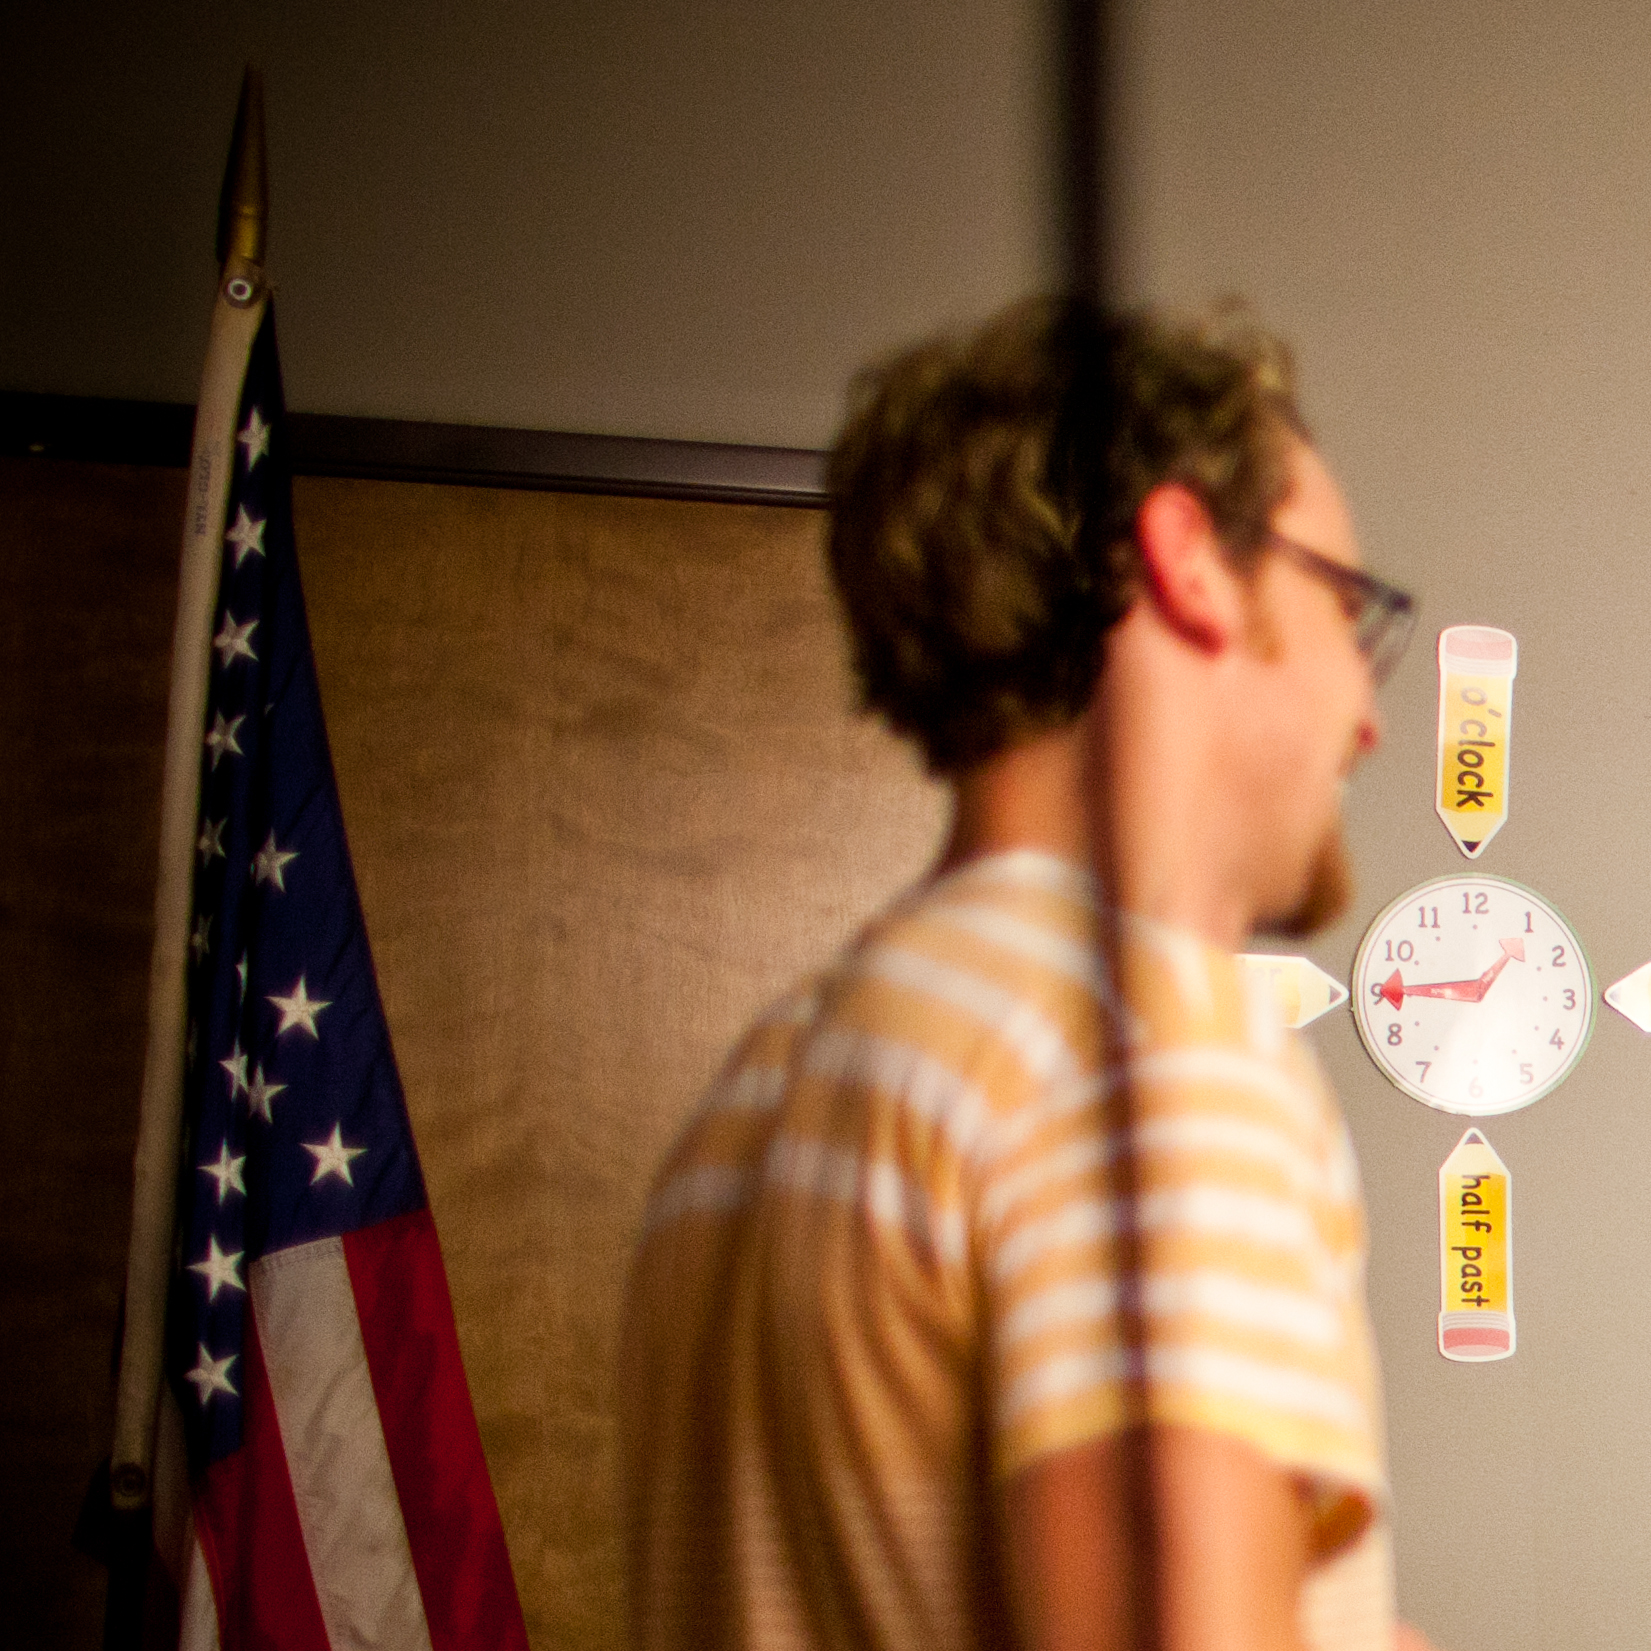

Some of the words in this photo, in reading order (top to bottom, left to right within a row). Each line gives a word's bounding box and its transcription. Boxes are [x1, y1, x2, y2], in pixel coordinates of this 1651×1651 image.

[1456, 685, 1503, 808] o'clock
[1462, 891, 1490, 915] 12
[1418, 905, 1441, 929] 11
[1524, 910, 1534, 933] 1
[1384, 939, 1414, 962] 10
[1551, 945, 1567, 968] 2
[1562, 988, 1577, 1011] 3
[1387, 1022, 1403, 1046] 8
[1548, 1027, 1565, 1050] 4
[1415, 1060, 1432, 1084] 7
[1519, 1062, 1535, 1085] 5
[1468, 1076, 1484, 1099] 6
[1459, 1172, 1493, 1236] half
[1451, 1244, 1491, 1309] past
